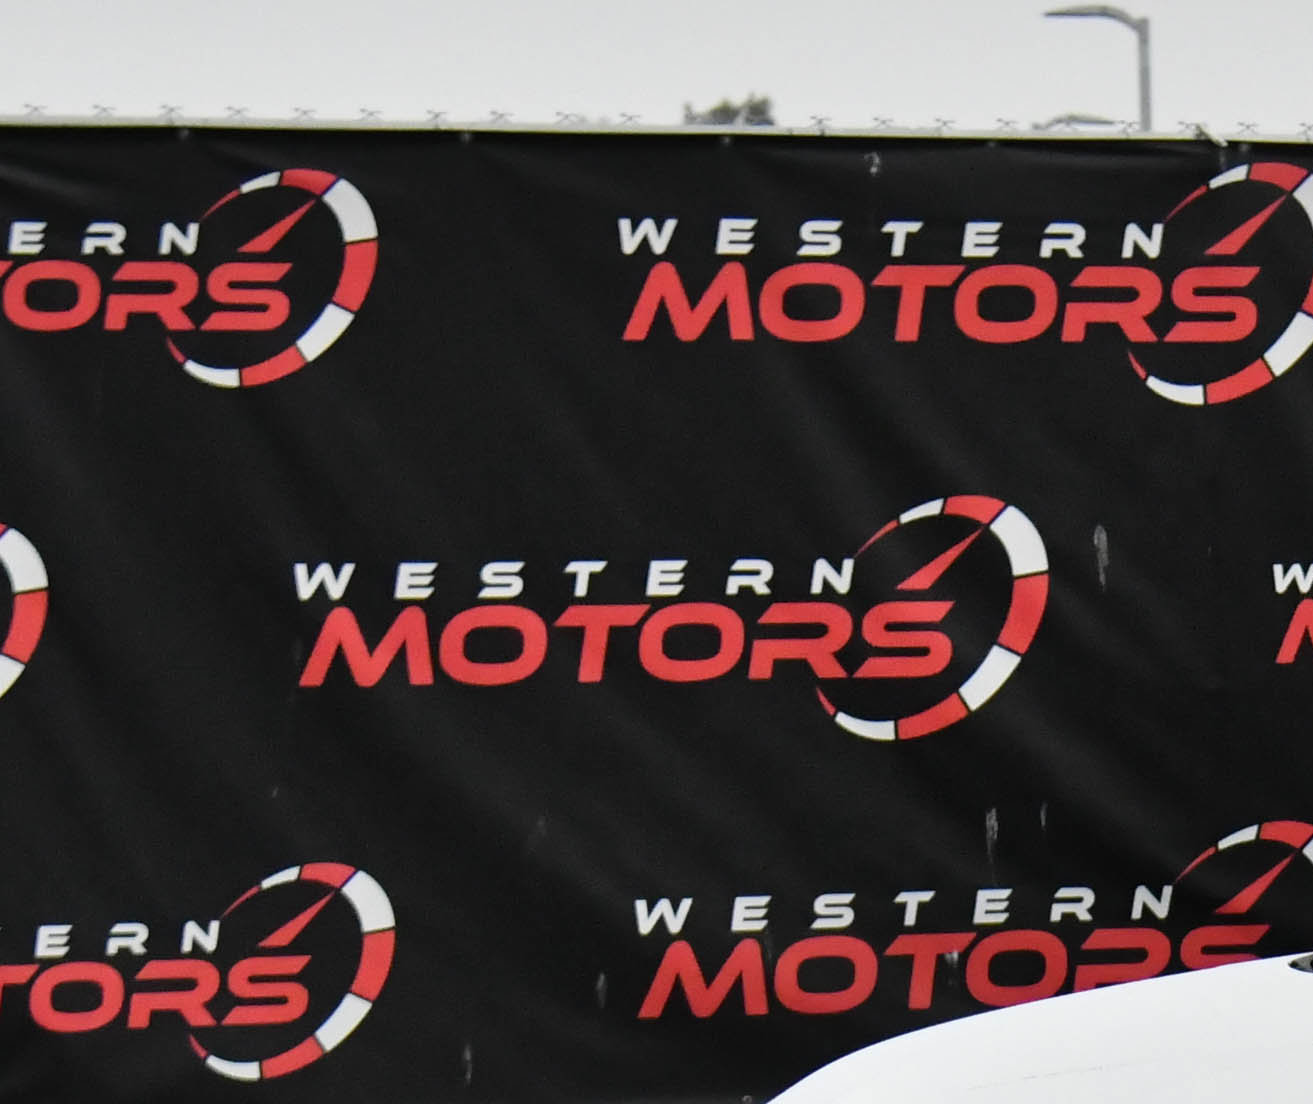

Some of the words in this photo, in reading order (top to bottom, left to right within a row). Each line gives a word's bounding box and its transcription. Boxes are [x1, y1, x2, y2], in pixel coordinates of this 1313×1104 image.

[619, 218, 1163, 258] WESTERN
[0, 260, 291, 331] ORS
[623, 262, 1260, 343] MOTORS
[294, 559, 853, 600] WESTERN
[300, 601, 954, 687] MOTORS
[635, 886, 1172, 934] WESTERN
